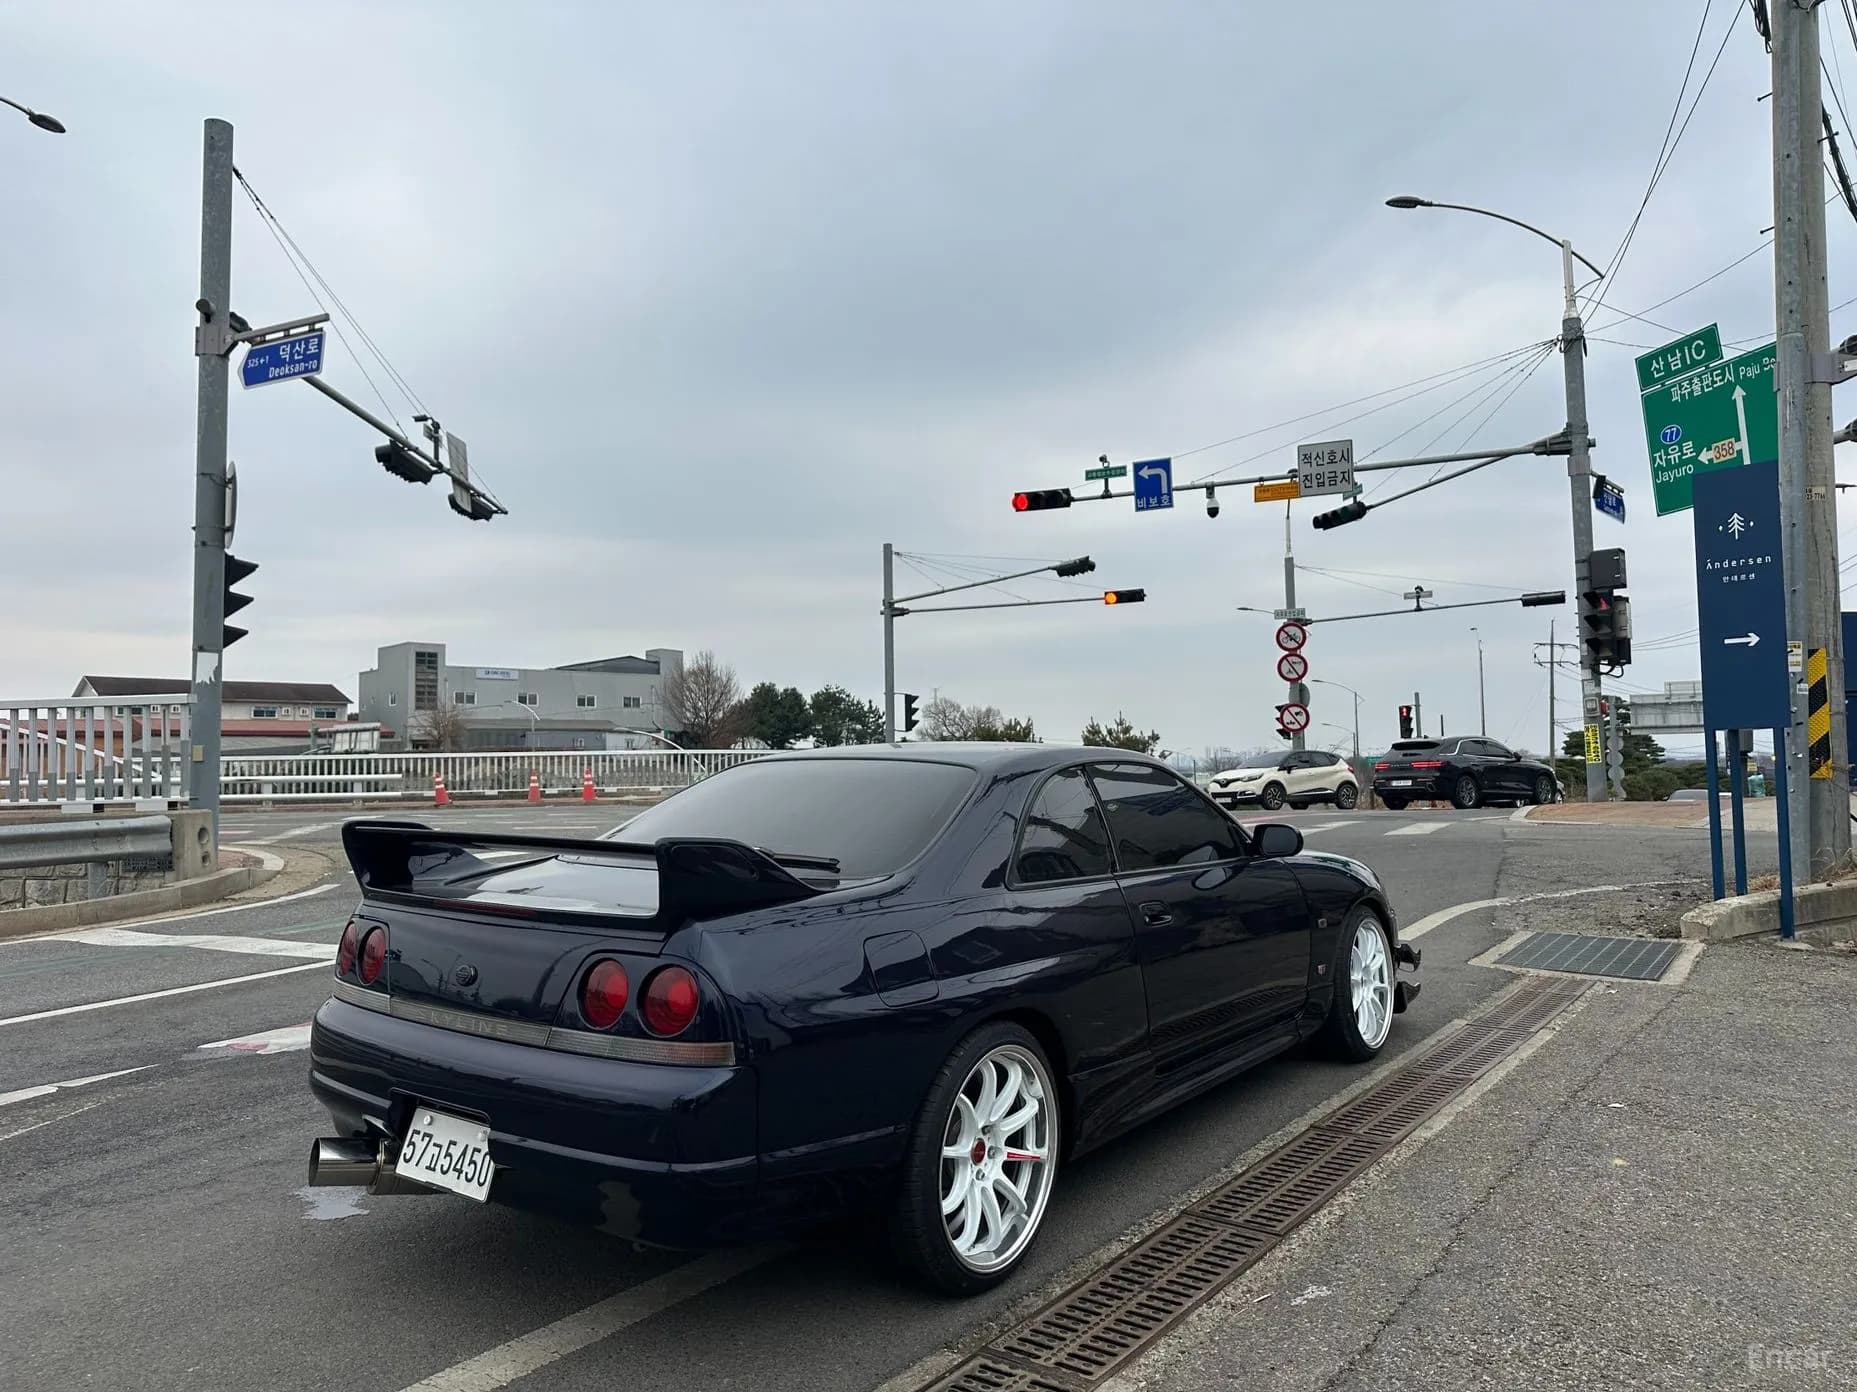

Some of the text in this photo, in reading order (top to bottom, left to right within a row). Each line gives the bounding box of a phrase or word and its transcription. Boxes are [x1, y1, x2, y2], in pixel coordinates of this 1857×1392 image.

[280, 338, 319, 362] 덕산로
[1650, 339, 1706, 378] 산남IC
[247, 356, 260, 368] 325
[269, 360, 318, 378] Deoksan-ro
[1671, 364, 1735, 402] 파주출판도시
[1739, 362, 1760, 380] Paju
[1665, 428, 1677, 440] 77
[1301, 448, 1350, 467] 적신호시
[1653, 440, 1697, 468] 자유로
[1713, 440, 1735, 460] 358
[1302, 468, 1350, 489] 진입금지
[1656, 462, 1694, 483] Jayuro
[1137, 494, 1170, 508] 비보호
